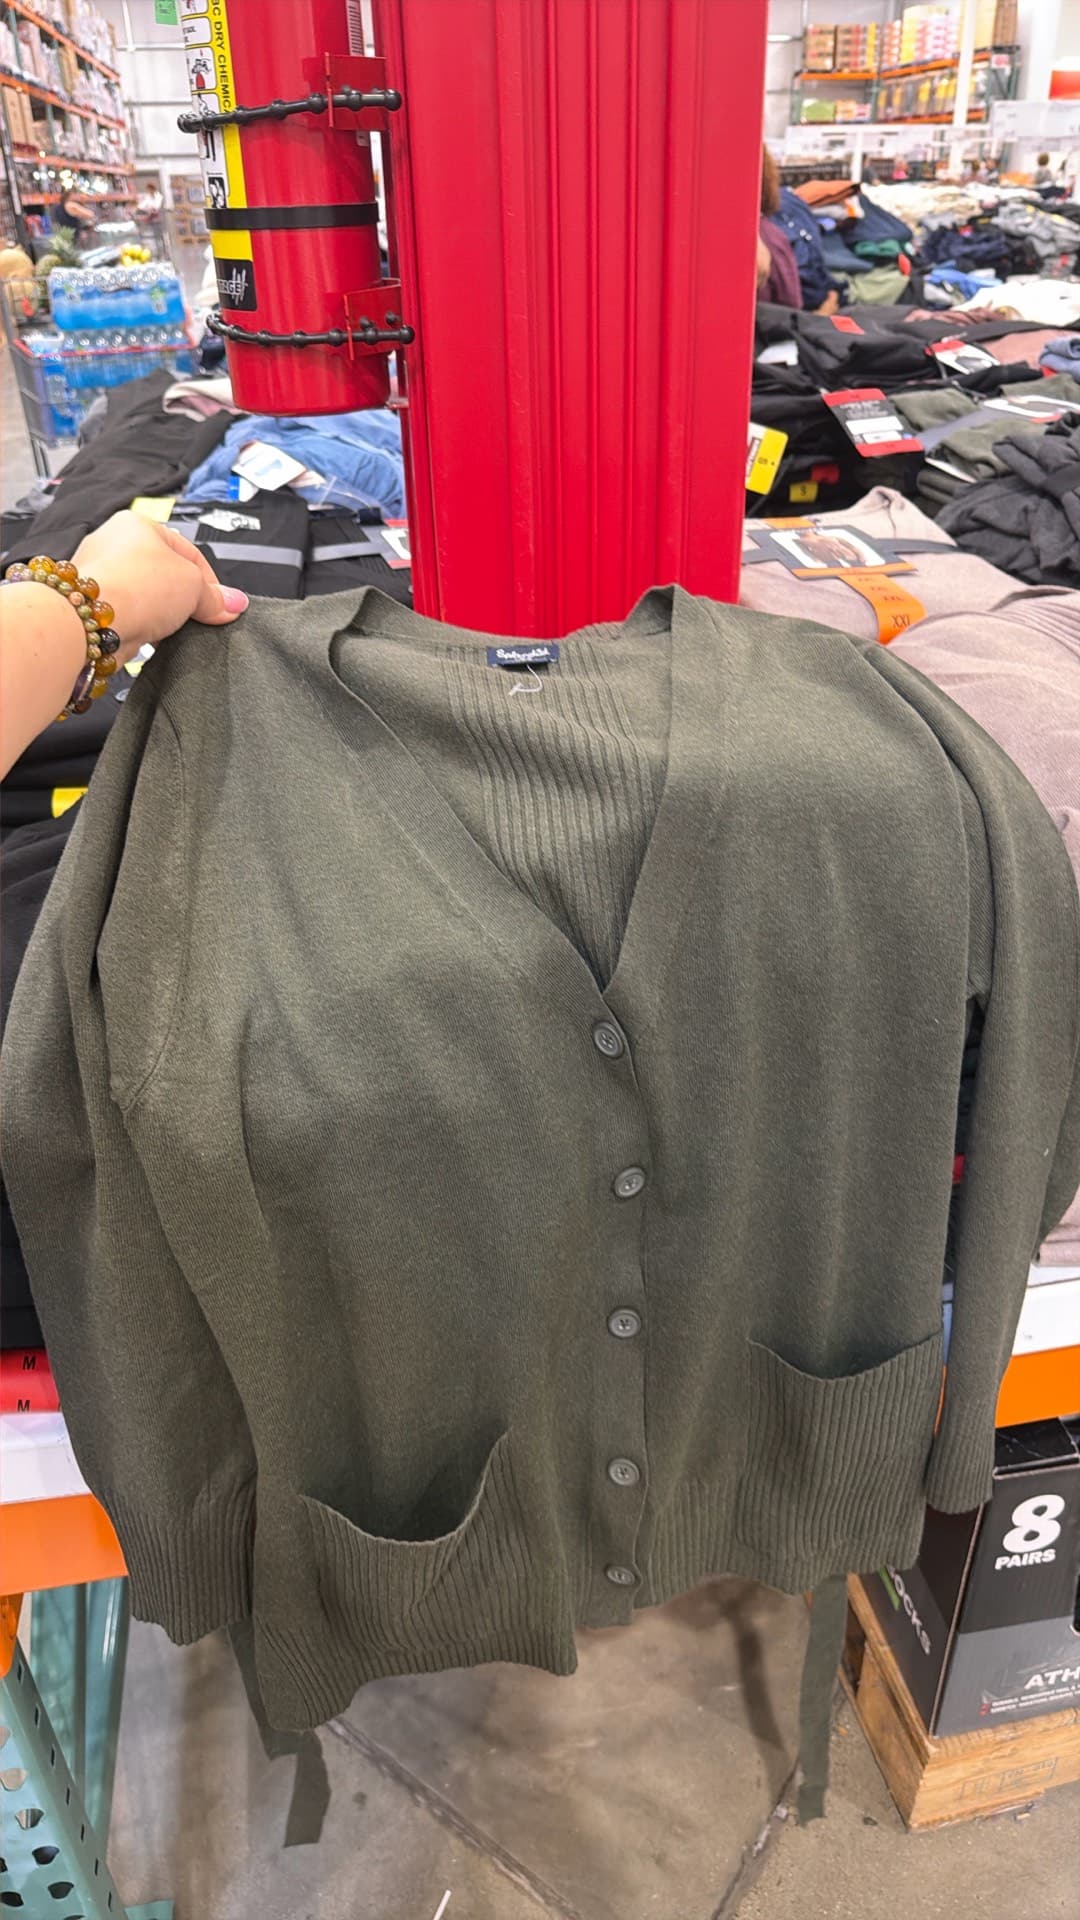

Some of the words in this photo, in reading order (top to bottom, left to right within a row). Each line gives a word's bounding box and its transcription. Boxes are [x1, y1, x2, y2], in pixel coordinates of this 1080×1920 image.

[214, 21, 225, 50] DRY
[23, 1356, 36, 1370] M
[17, 1400, 30, 1412] M
[1003, 1494, 1065, 1553] 8
[994, 1548, 1056, 1570] PAIRS
